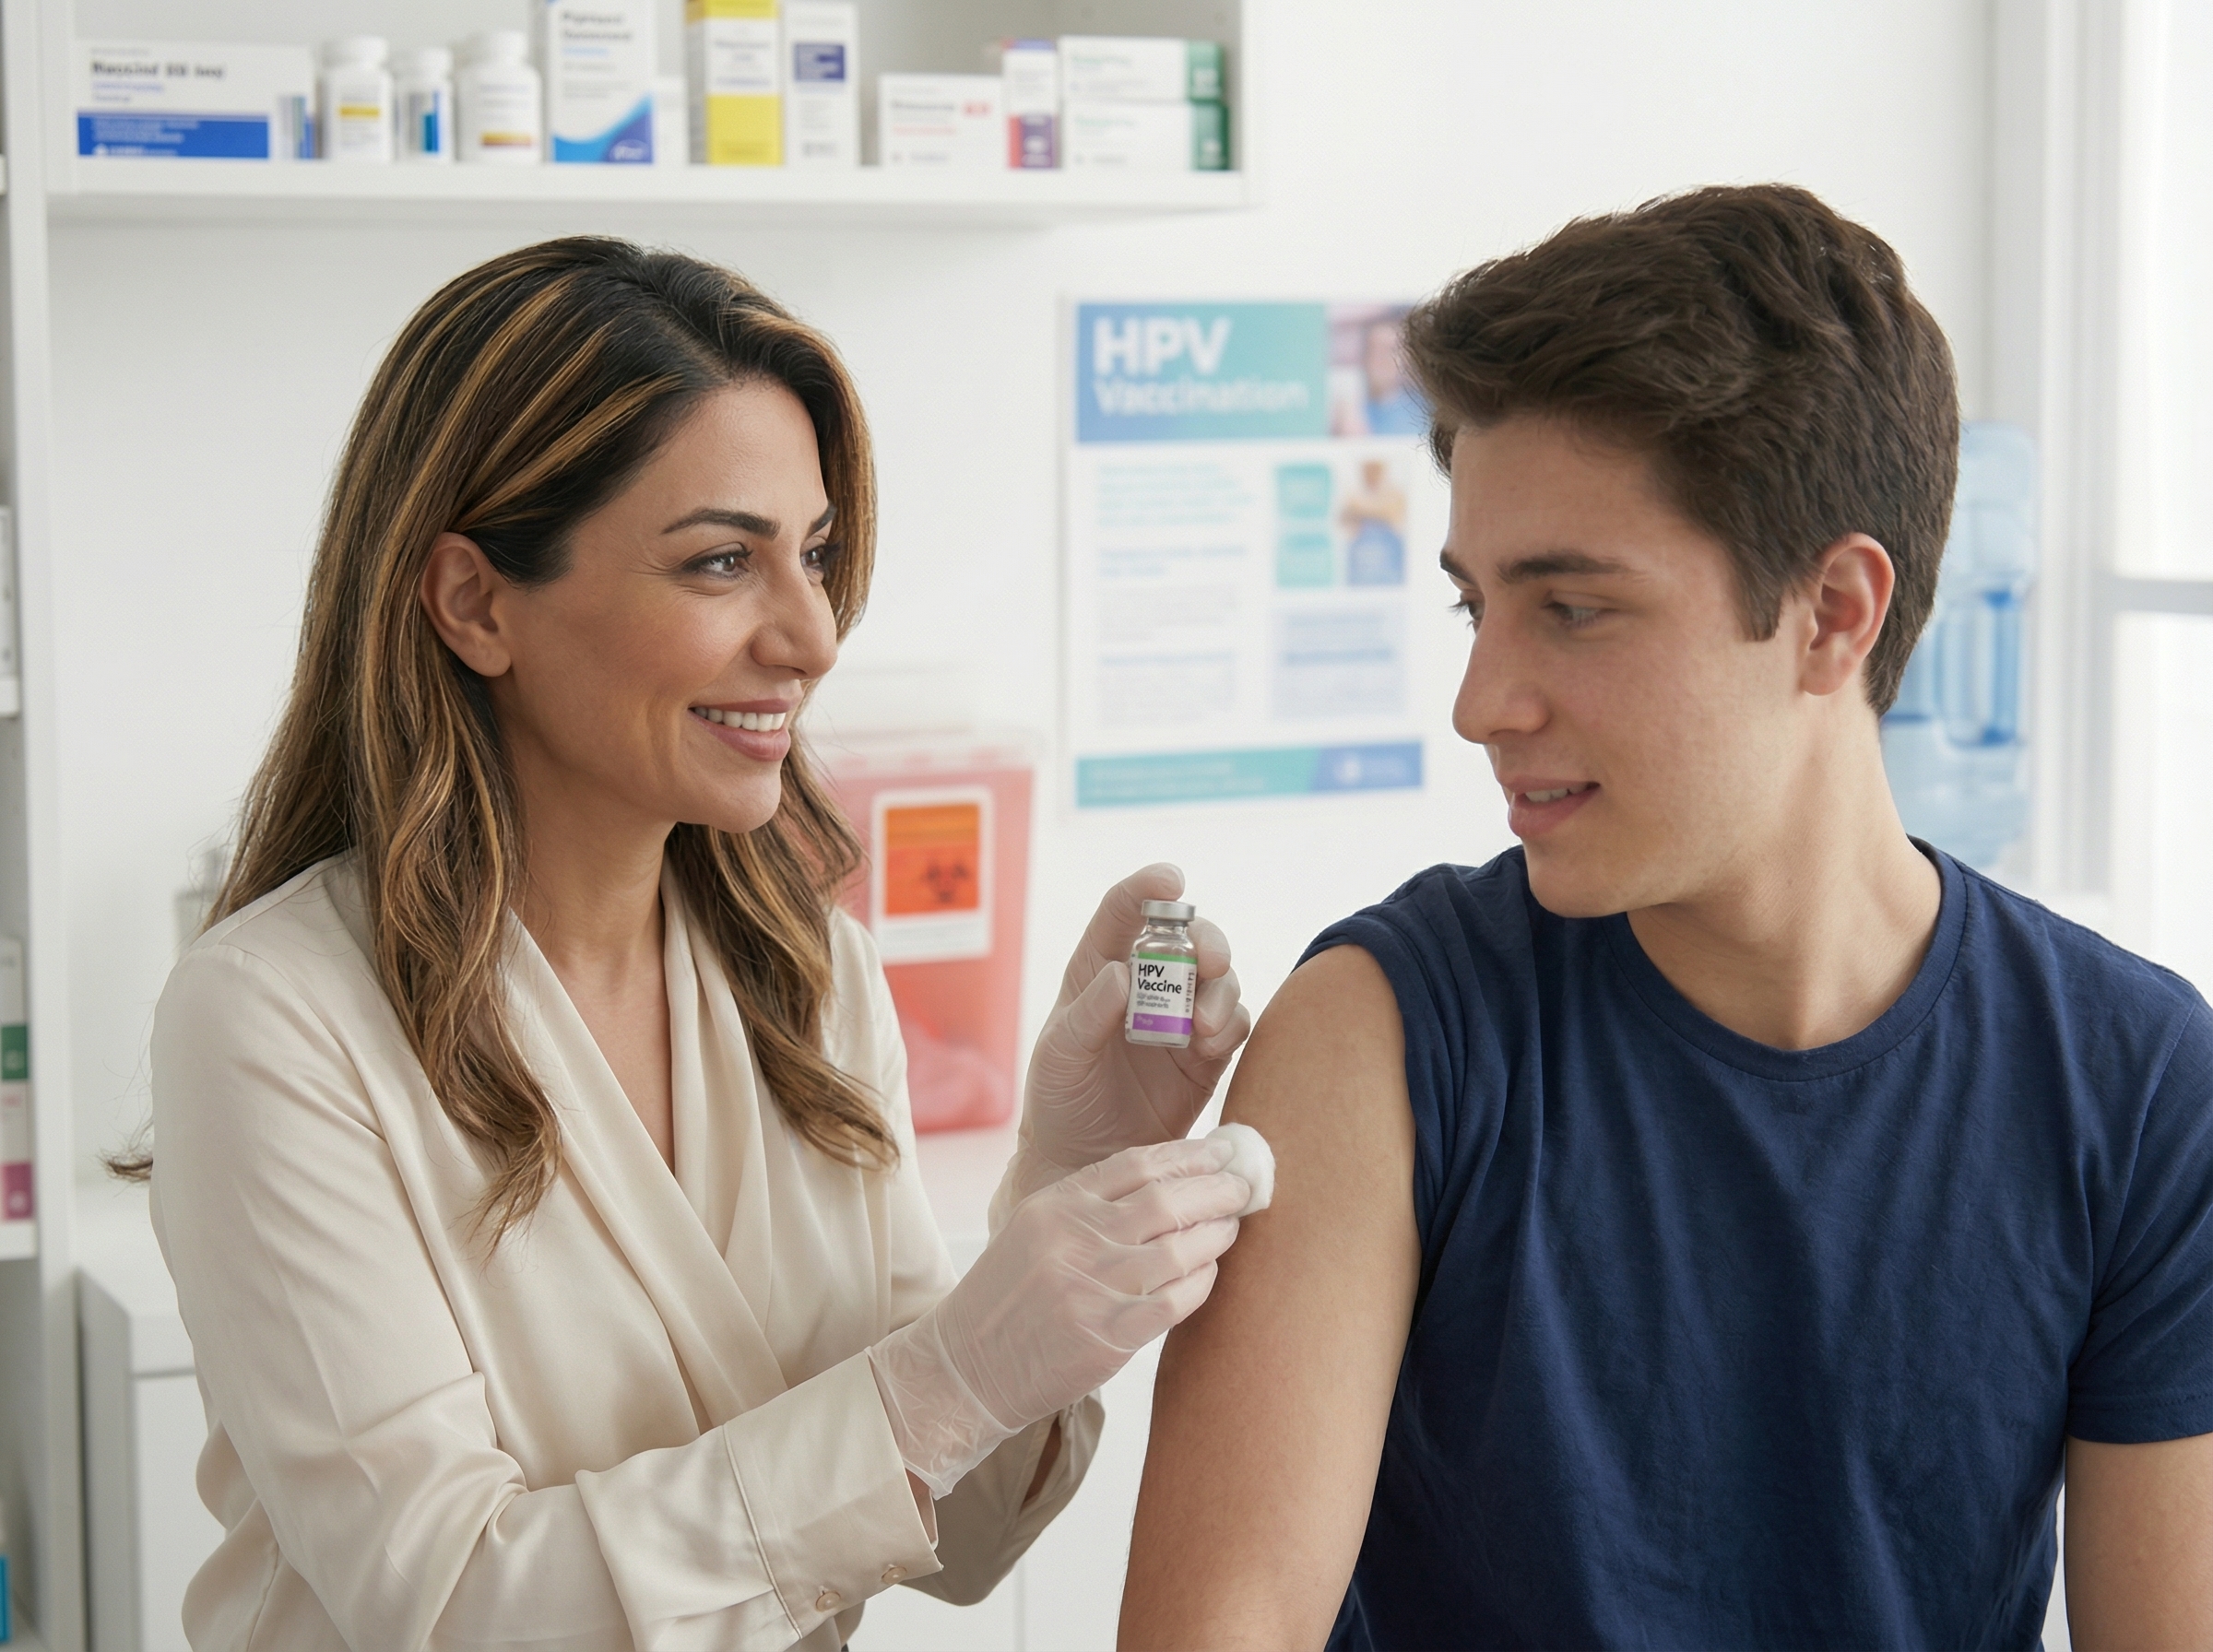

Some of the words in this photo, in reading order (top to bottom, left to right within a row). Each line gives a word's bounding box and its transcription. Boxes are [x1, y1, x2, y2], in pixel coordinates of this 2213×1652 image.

[1094, 317, 1232, 376] HPV
[1094, 378, 1309, 415] Vaccination
[1138, 963, 1165, 977] HPV
[1138, 977, 1182, 994] Vaccine
